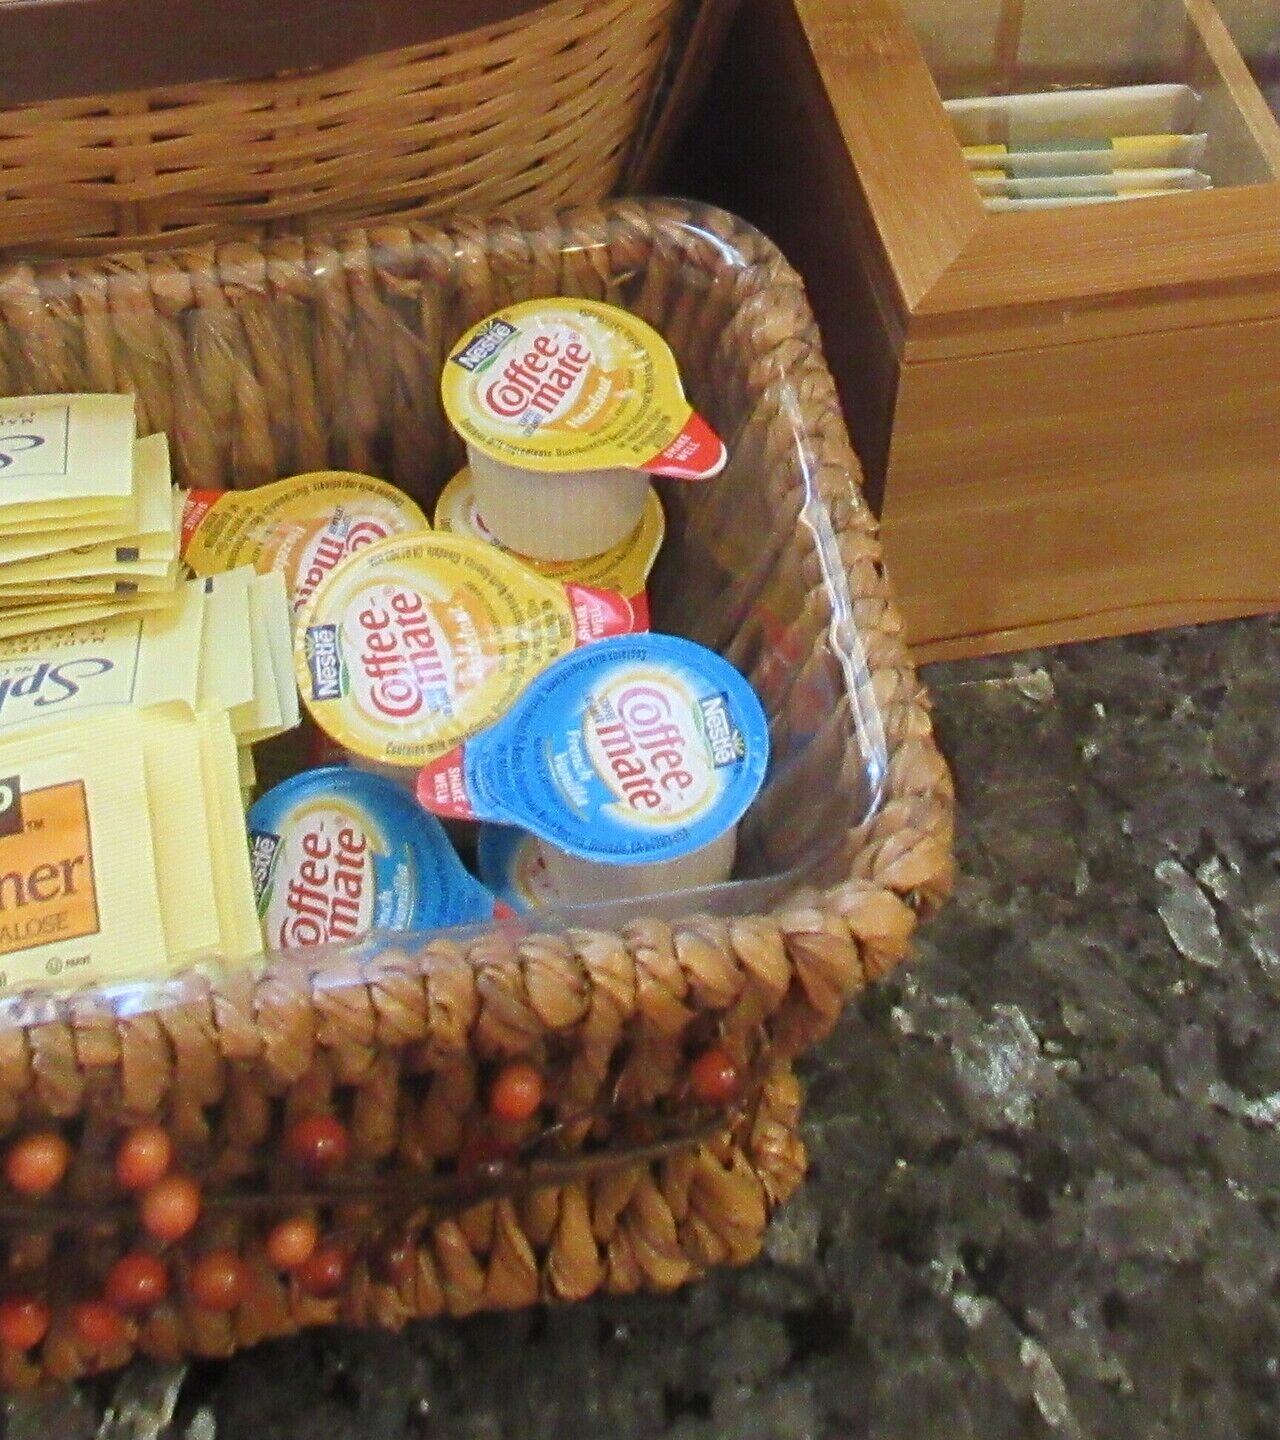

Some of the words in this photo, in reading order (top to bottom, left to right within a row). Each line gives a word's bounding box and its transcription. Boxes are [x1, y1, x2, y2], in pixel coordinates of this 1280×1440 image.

[530, 341, 592, 415] mate
[391, 590, 449, 694] mate
[595, 720, 664, 810] mate
[327, 827, 368, 939] mate
